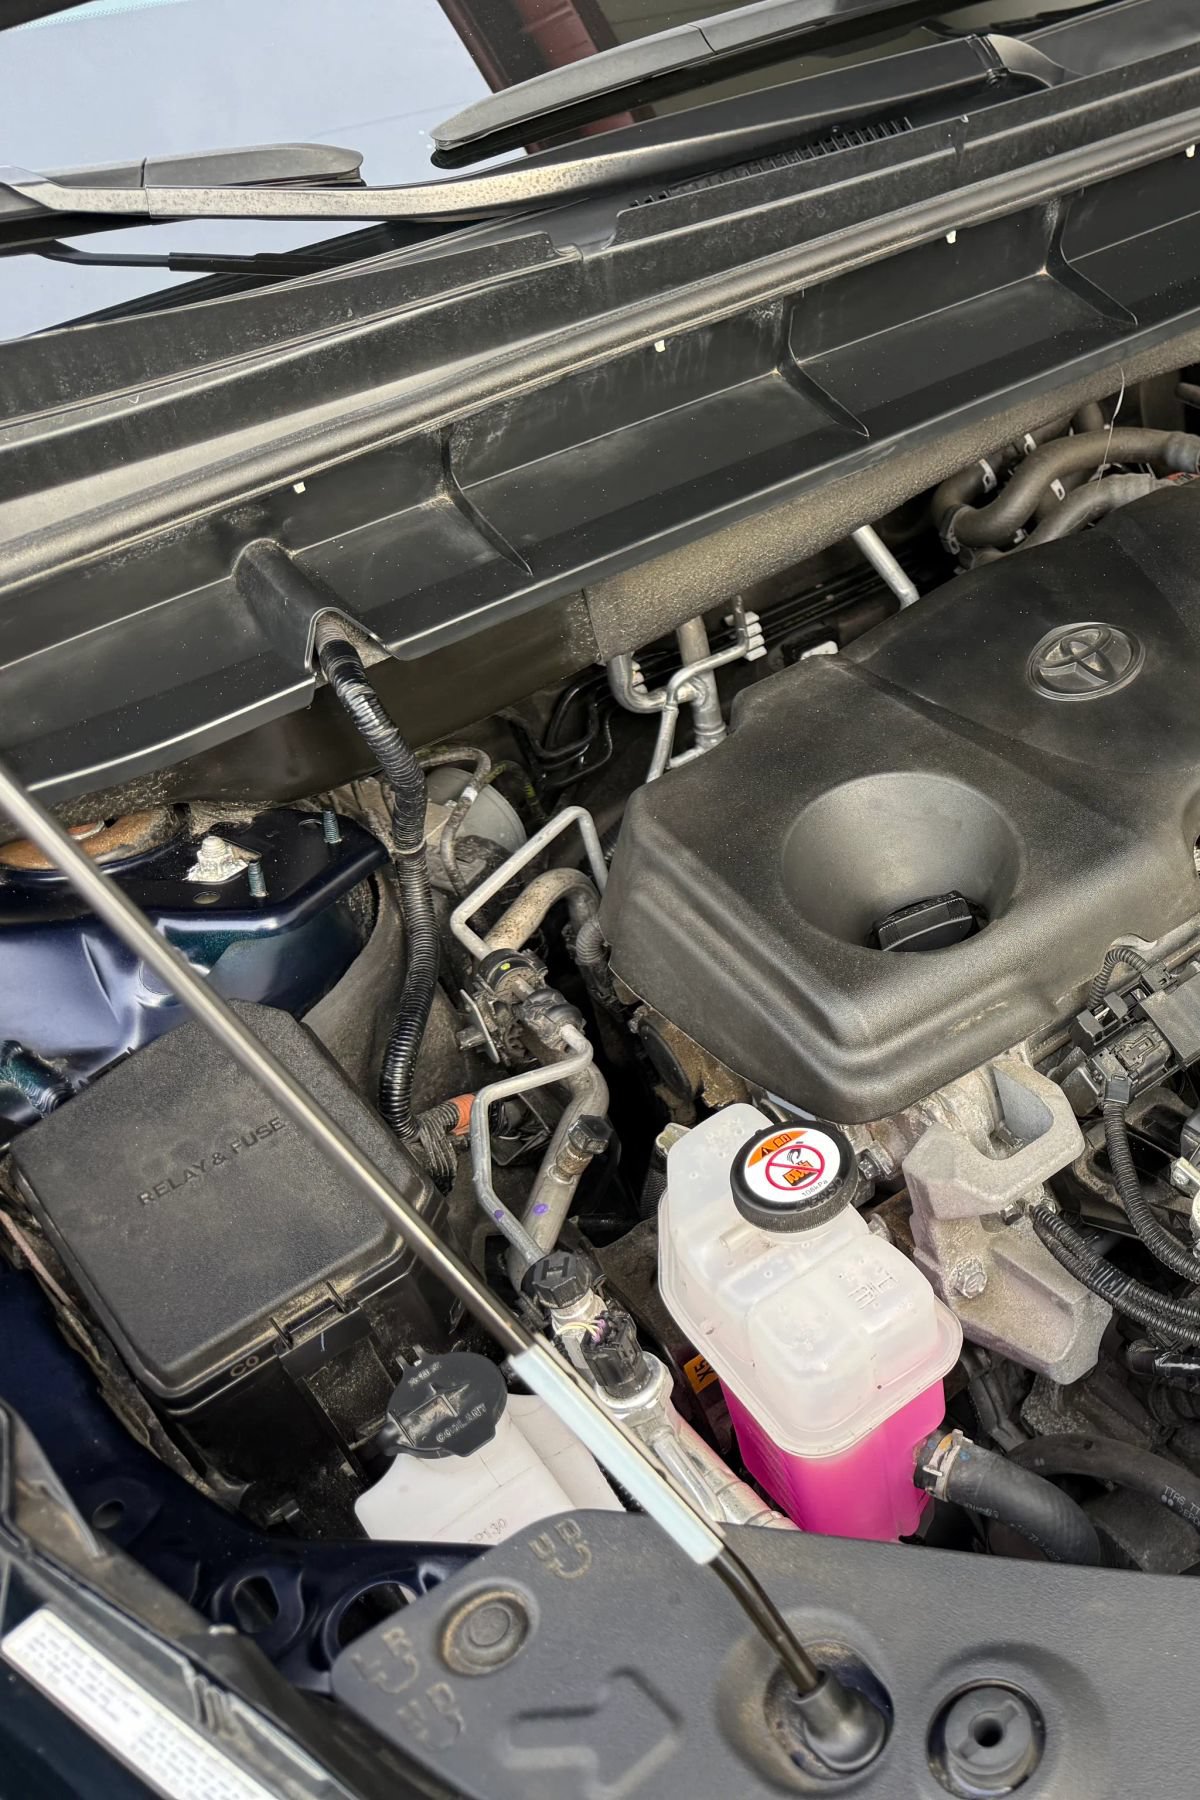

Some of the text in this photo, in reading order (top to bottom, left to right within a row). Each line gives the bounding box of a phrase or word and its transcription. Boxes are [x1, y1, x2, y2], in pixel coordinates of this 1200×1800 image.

[137, 1116, 286, 1205] RELAY & FUSE
